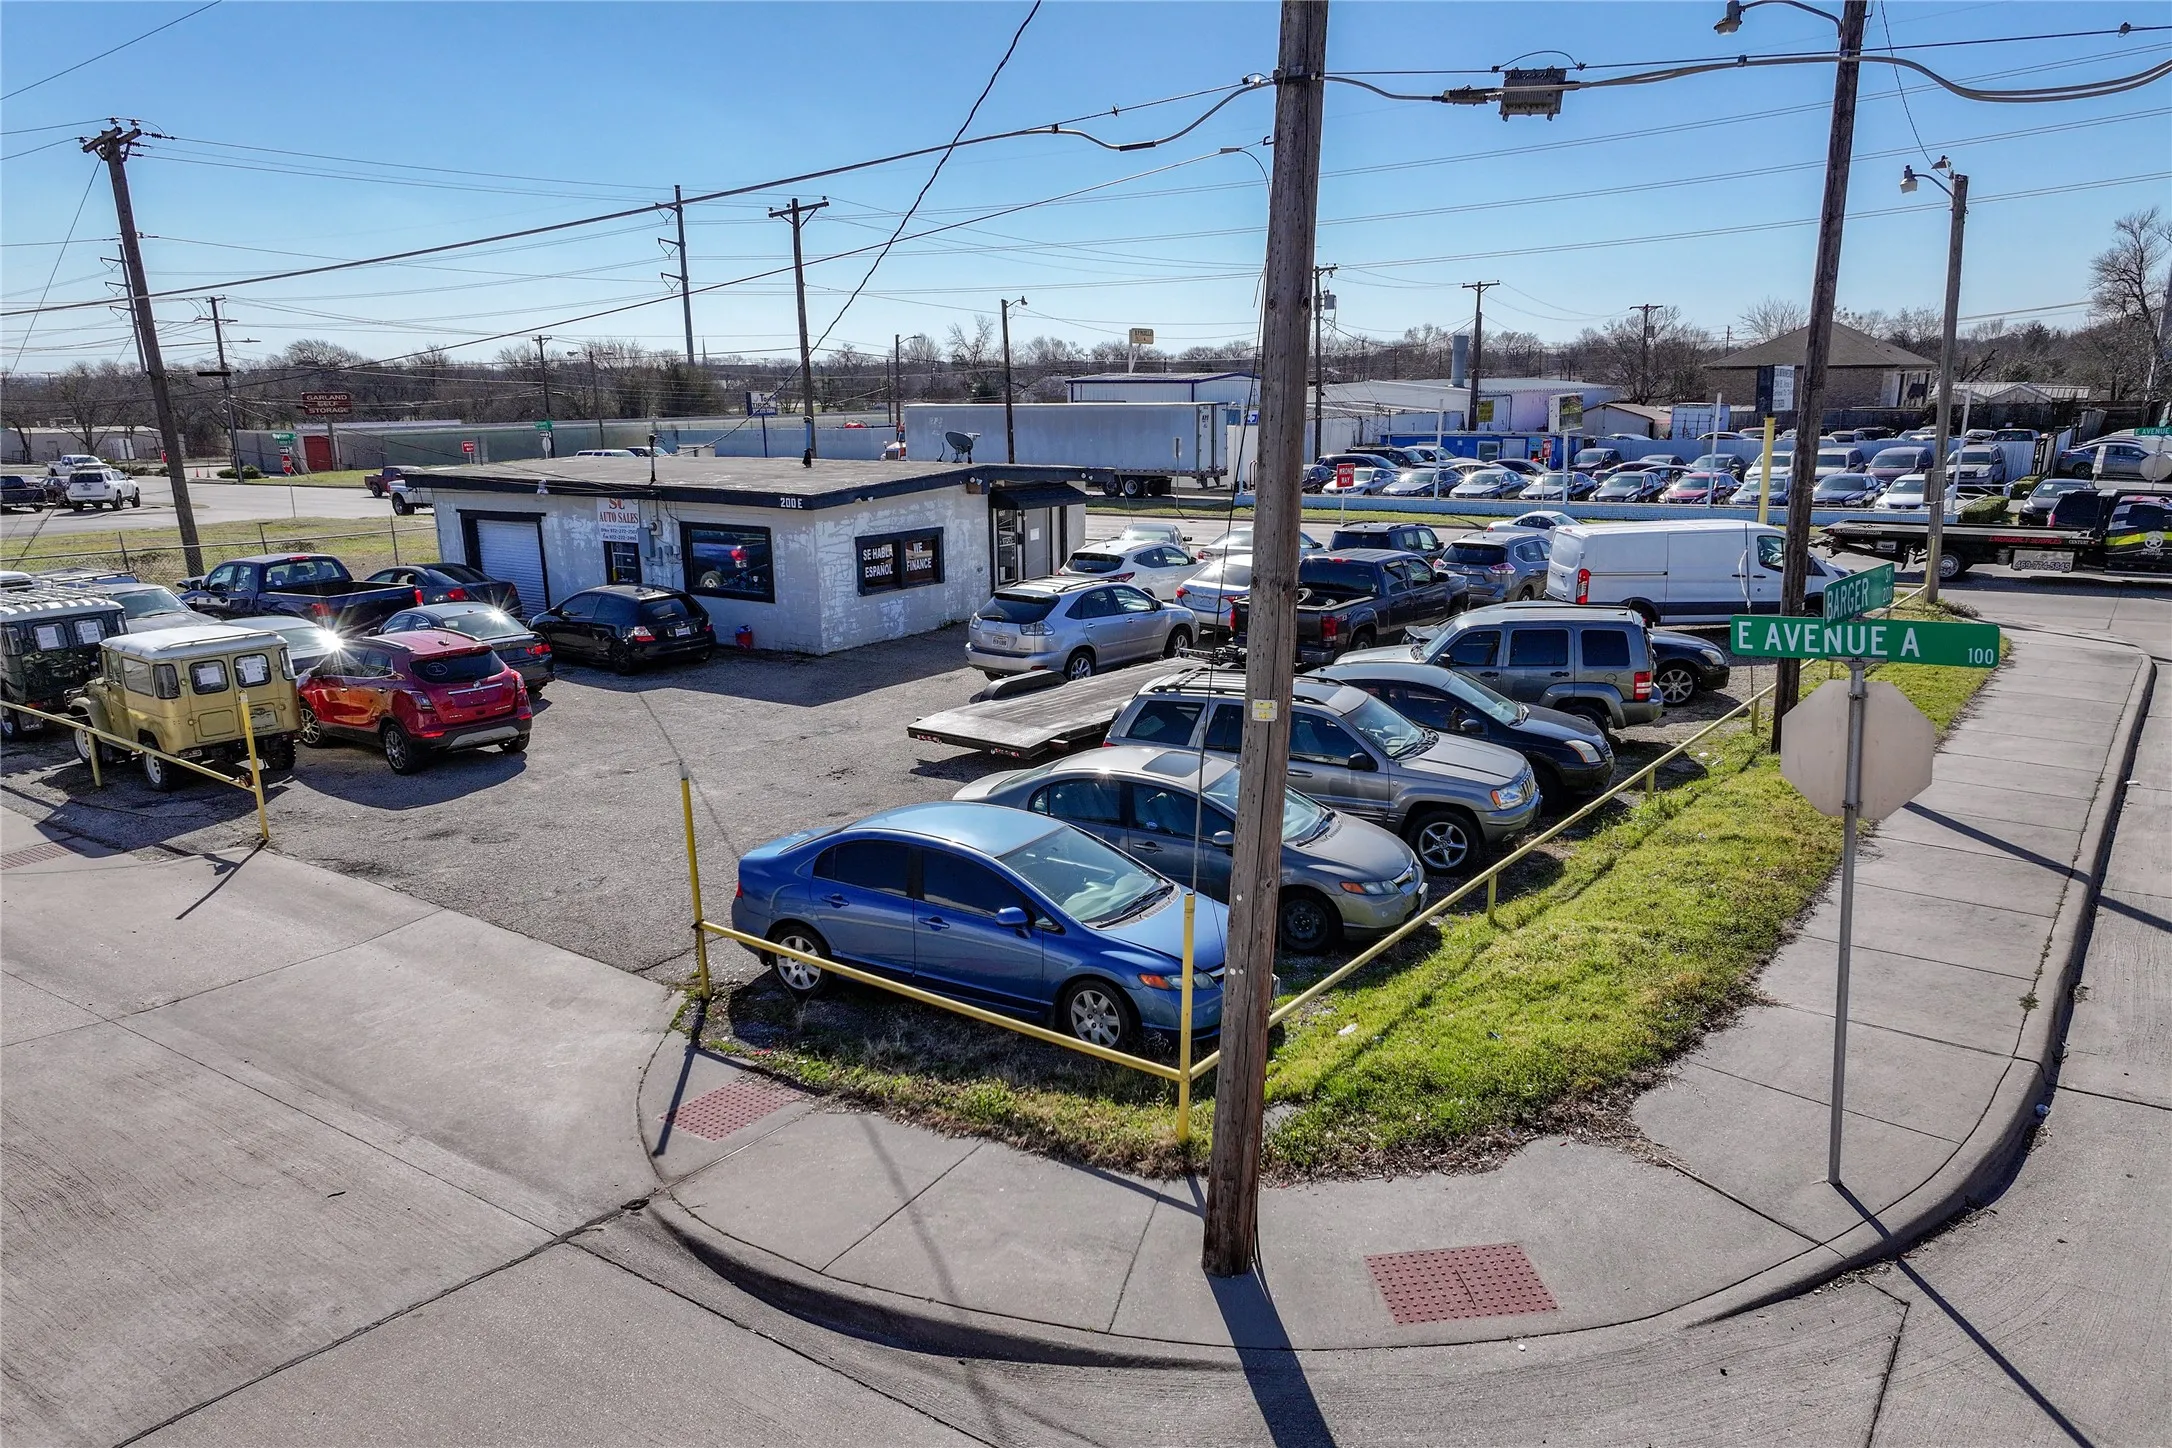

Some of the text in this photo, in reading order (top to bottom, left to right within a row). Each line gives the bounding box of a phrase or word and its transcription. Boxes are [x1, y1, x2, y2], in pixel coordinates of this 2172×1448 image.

[2142, 427, 2170, 435] AVENUE
[1339, 467, 1353, 475] WRONG
[780, 497, 803, 509] 200 E
[600, 511, 639, 524] AUTO SALES
[862, 546, 893, 561] SE HABLA
[912, 542, 922, 554] WE
[864, 562, 893, 578] ESPAÑOL
[906, 557, 932, 572] FINANCE
[2014, 560, 2071, 571] 469-774-5845
[1885, 567, 1893, 583] ST
[1826, 578, 1869, 621] BARGER
[1738, 621, 1994, 665] E AVENUE A 100
